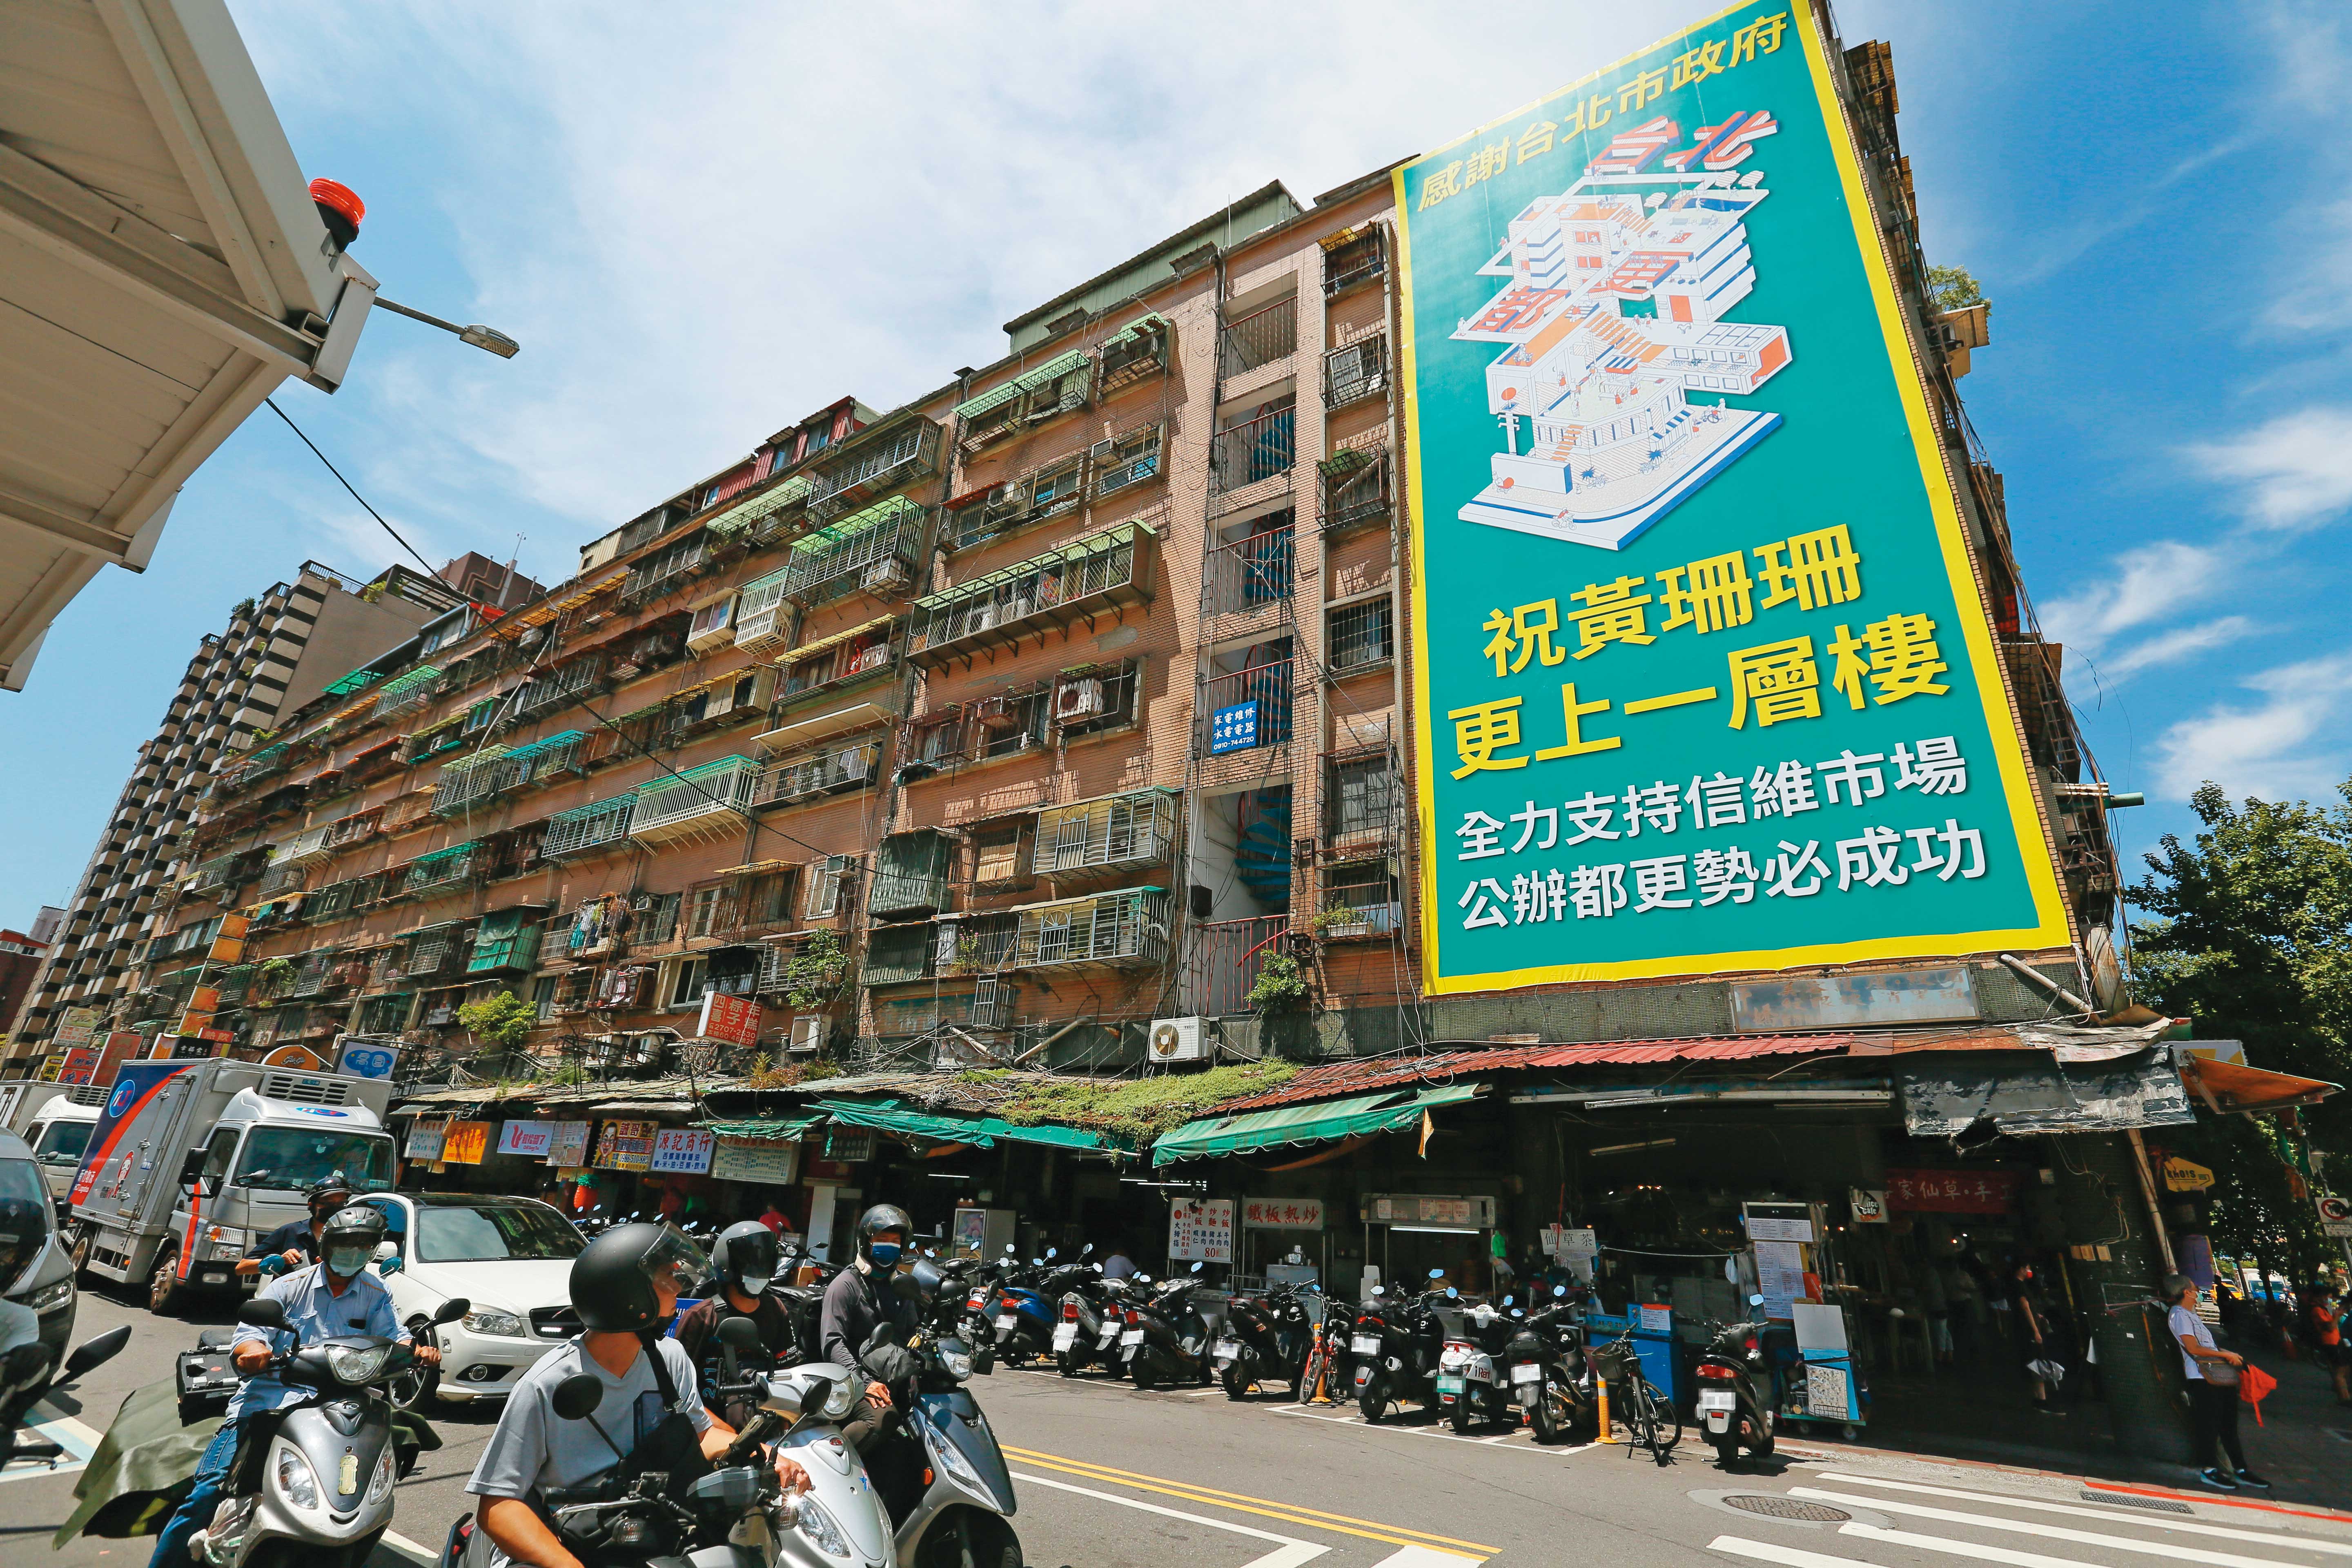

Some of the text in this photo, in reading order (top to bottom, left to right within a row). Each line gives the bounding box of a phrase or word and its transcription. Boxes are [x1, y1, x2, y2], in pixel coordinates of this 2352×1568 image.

[1418, 11, 1787, 212] 感謝台北市政府
[1482, 523, 1860, 677] 祝黃珊珊
[1448, 613, 1951, 781] 更上一層樓
[1214, 707, 1256, 726] 家電維修
[1214, 736, 1254, 750] 0910-744720
[1455, 736, 1968, 862] 全力支持信維市場
[1458, 818, 1987, 931] 公辦都更勢必成功
[711, 994, 726, 1022] 四喜
[619, 1122, 641, 1137] 誠哥
[658, 1132, 711, 1153] 源記商行
[1208, 1207, 1217, 1227] 炒麵
[1221, 1208, 1230, 1228] 炒飯
[1247, 1203, 1319, 1225] 鐵板熱炒
[1544, 1233, 1592, 1246] 仙草茶
[1205, 1247, 1216, 1258] 80
